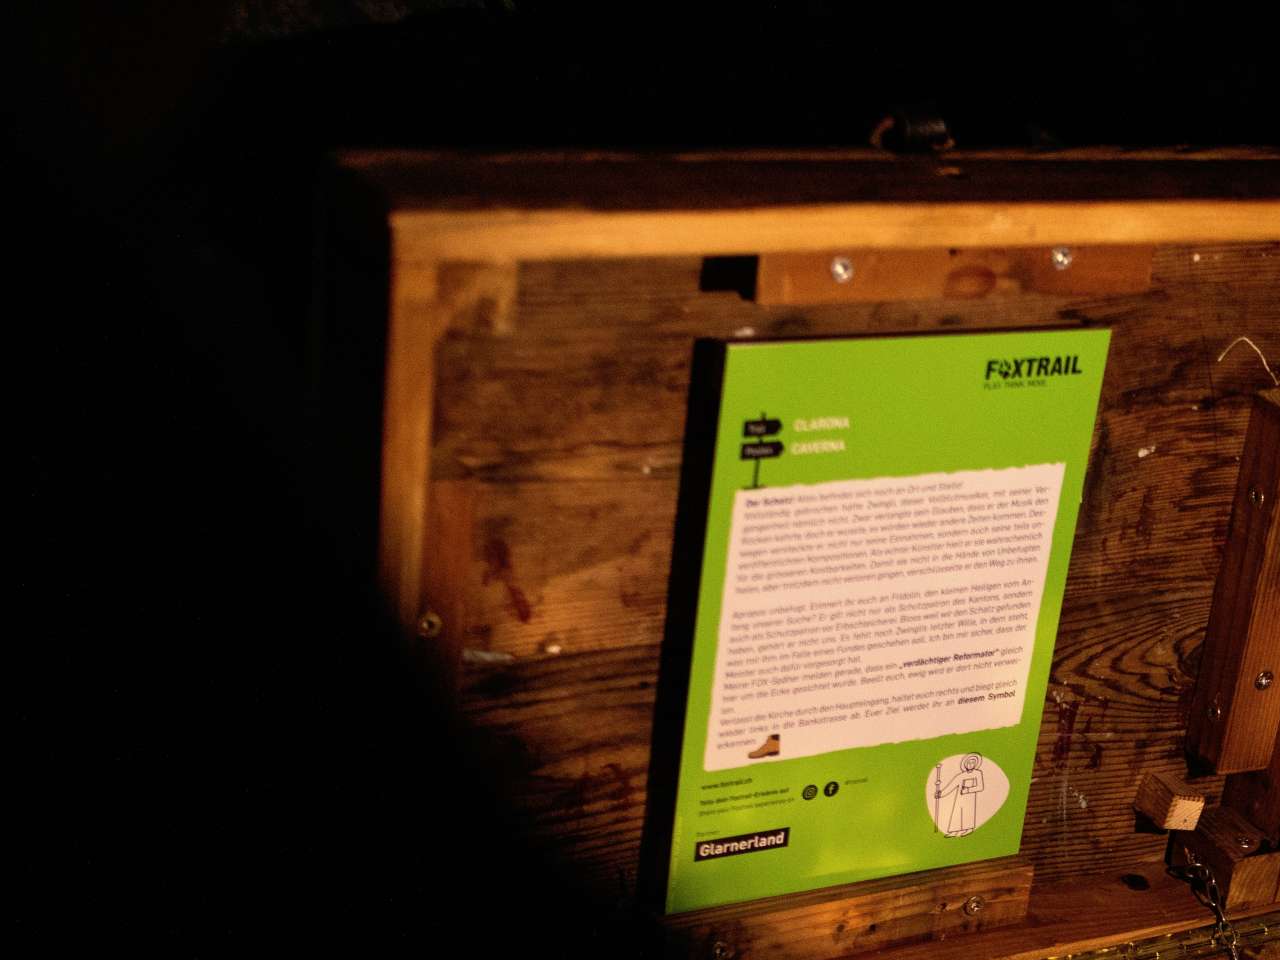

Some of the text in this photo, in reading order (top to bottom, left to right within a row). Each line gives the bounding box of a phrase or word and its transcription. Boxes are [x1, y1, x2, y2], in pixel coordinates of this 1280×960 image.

[985, 356, 1082, 380] FOXTRAIL
[956, 693, 986, 703] diesem
[986, 689, 1016, 701] Symbol
[699, 831, 785, 857] Glarnerland
